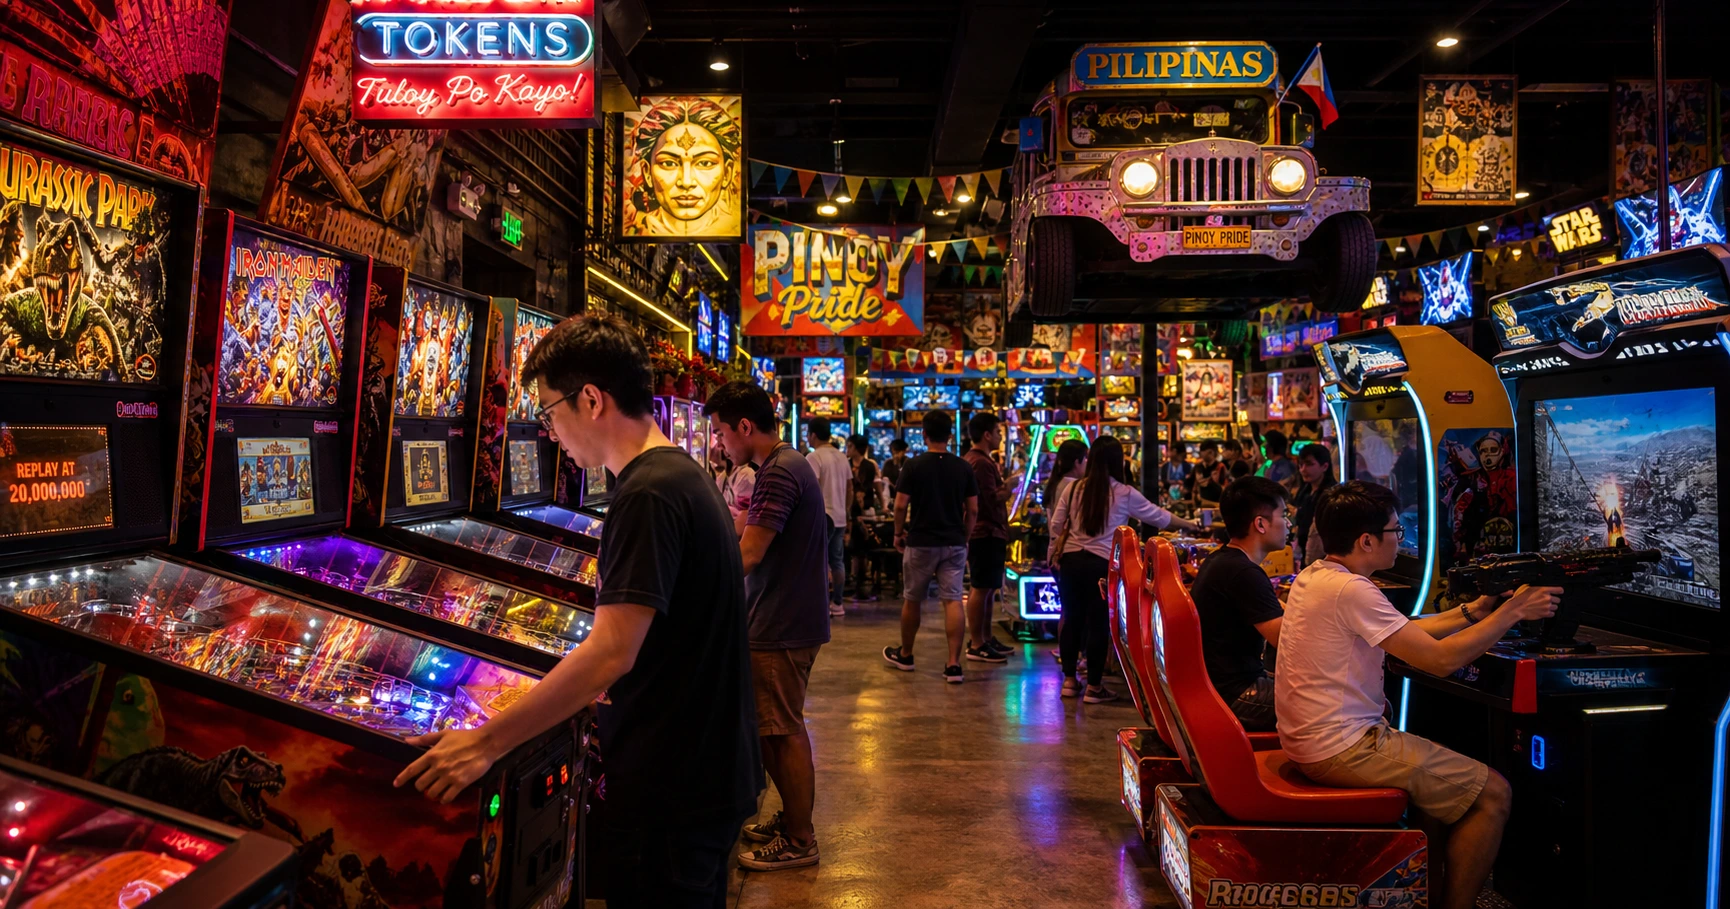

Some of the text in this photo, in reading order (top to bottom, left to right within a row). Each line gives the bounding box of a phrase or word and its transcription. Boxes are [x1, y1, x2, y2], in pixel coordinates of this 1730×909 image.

[372, 21, 569, 56] TOKENS
[1087, 50, 1263, 79] PILIPINAS
[357, 73, 583, 115] Tuloy Po Kayo!
[0, 147, 93, 219] URASSIC
[1185, 230, 1249, 244] PINOY PRIDE
[1549, 207, 1600, 236] STAR
[1552, 222, 1602, 253] WARS
[236, 247, 336, 288] IRON MAIDEN
[754, 230, 916, 298] PINOY
[778, 283, 882, 328] Pride
[16, 461, 75, 478] REPLAY AT
[9, 480, 85, 505] 20,000,000
